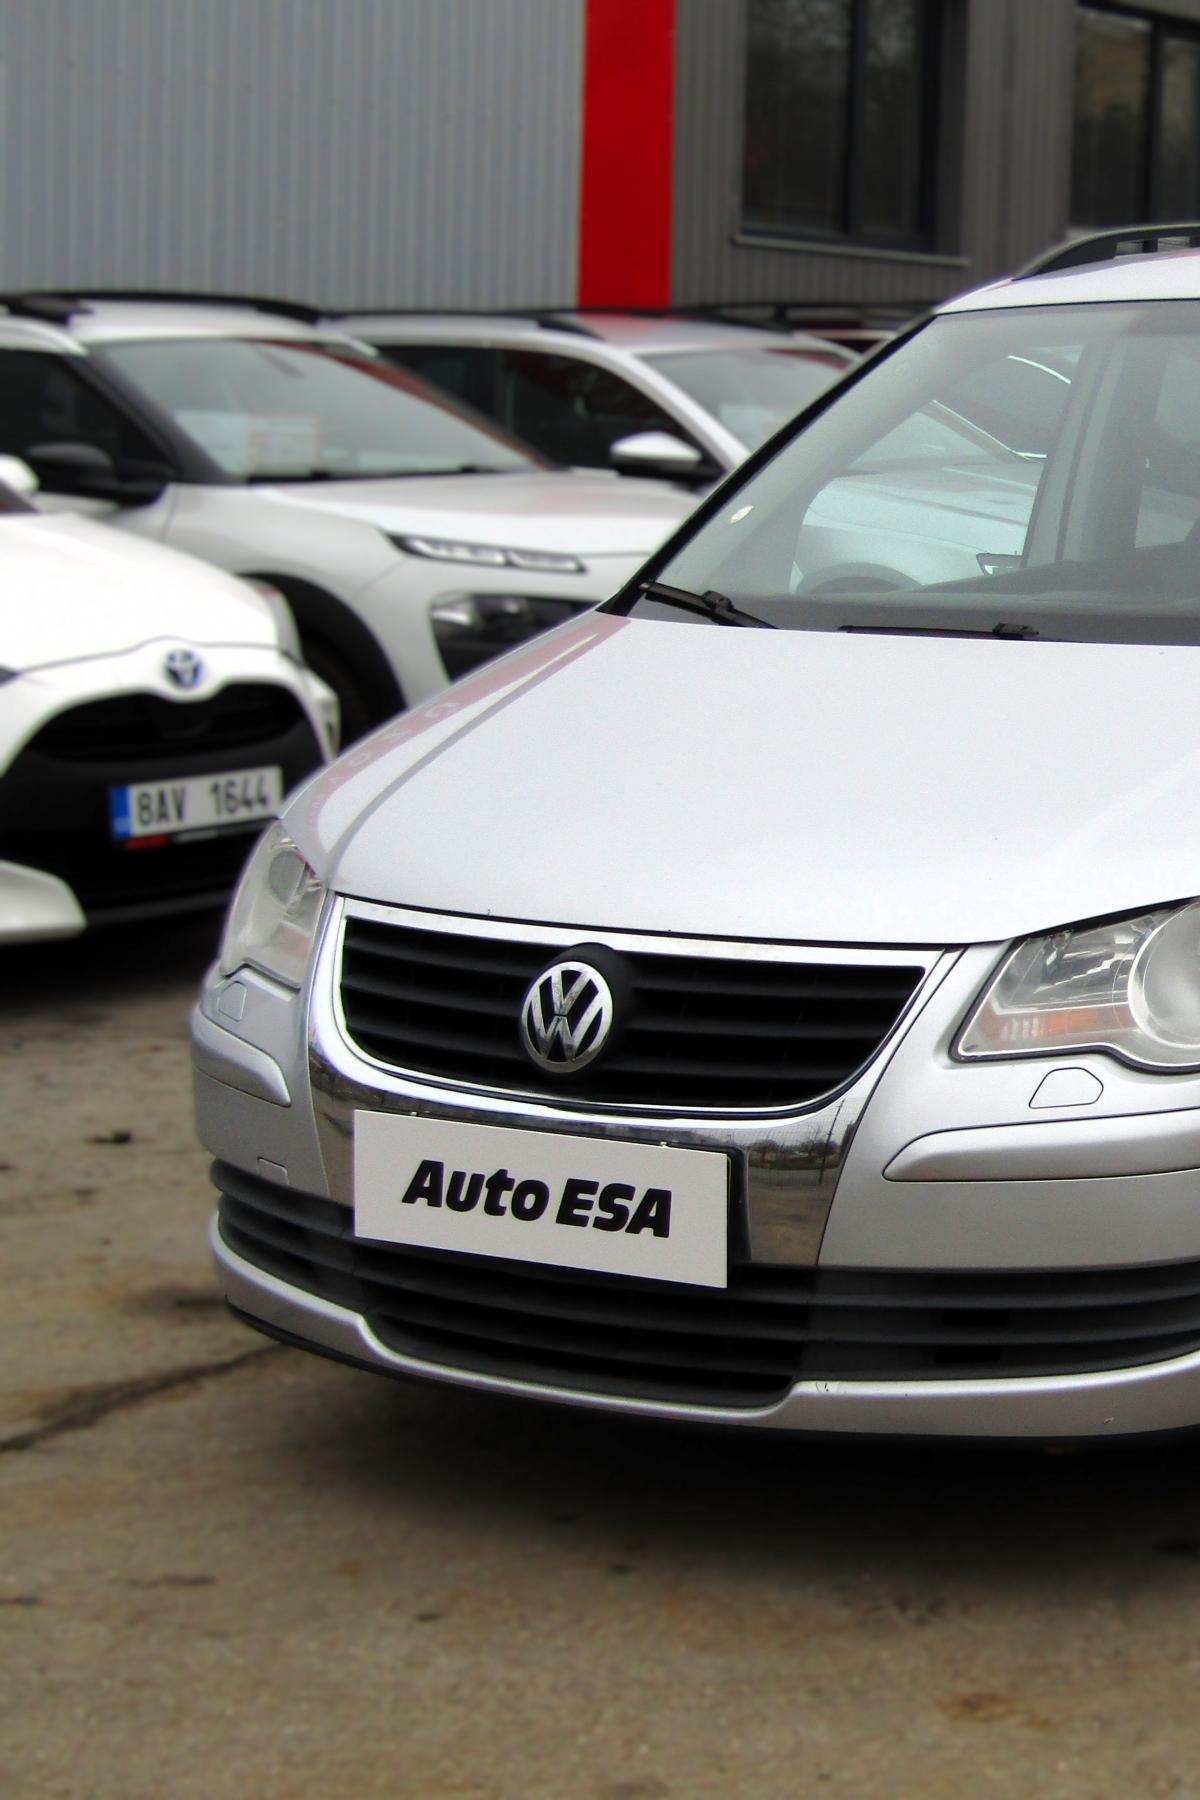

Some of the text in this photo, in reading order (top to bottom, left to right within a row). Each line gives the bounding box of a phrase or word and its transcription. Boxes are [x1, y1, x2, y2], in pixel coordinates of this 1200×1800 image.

[137, 774, 269, 827] 8AV 1644
[402, 1159, 672, 1238] Auto ESA
